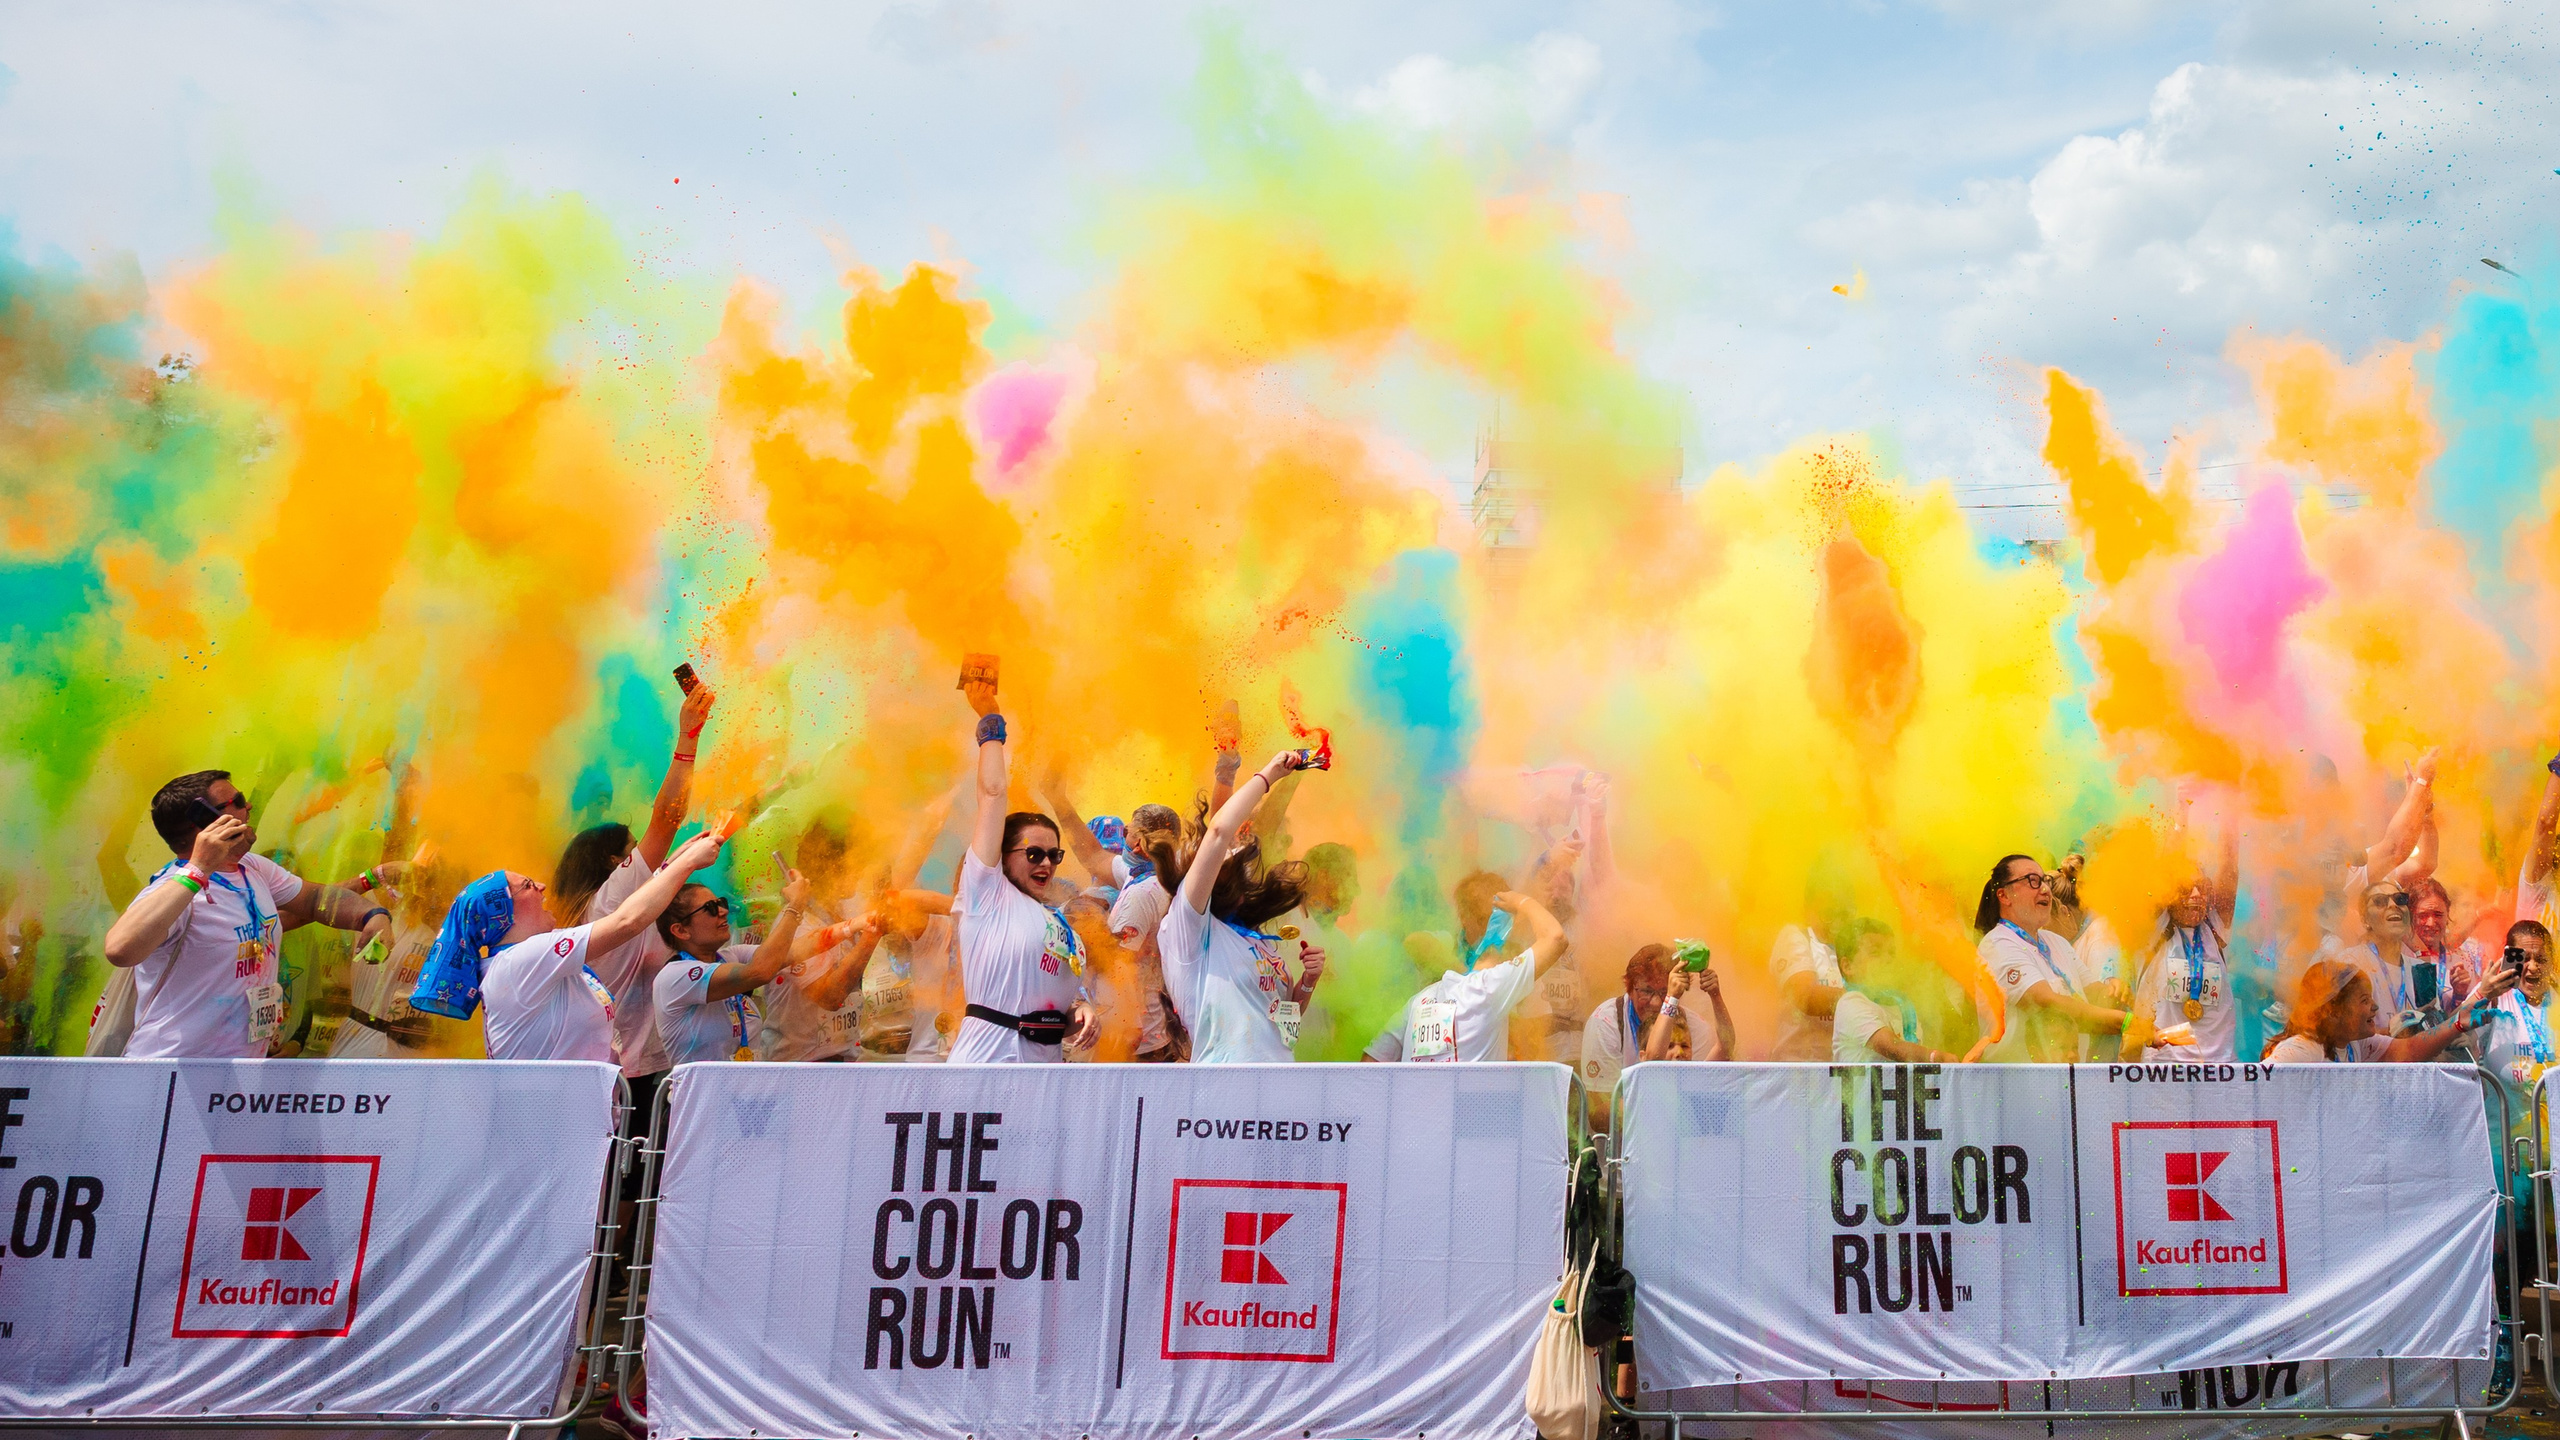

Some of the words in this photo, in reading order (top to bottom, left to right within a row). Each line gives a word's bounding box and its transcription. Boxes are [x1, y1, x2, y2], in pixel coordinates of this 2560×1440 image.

[968, 667, 994, 679] COLOR
[874, 988, 904, 1006] 17563
[2182, 976, 2210, 994] 156
[256, 1004, 276, 1027] 15390
[831, 1011, 857, 1032] 16138
[1417, 1023, 1441, 1043] 18119
[2512, 1042, 2533, 1057] THE
[2109, 1063, 2236, 1083] POWERED
[2244, 1063, 2275, 1083] BY
[207, 1093, 346, 1114] POWERED
[354, 1094, 391, 1114] BY
[1829, 1064, 1942, 1142] THE
[1176, 1118, 1309, 1141] POWERED
[1318, 1122, 1353, 1143] BY
[885, 1112, 1002, 1193] THE
[1831, 1145, 2032, 1228] COLOR
[0, 1175, 104, 1259] OR
[872, 1198, 1083, 1281] COLOR
[2136, 1238, 2267, 1265] Kaufland
[1832, 1231, 1954, 1315] RUN
[1955, 1285, 1972, 1302] TM
[198, 1278, 339, 1306] Kaufland
[863, 1286, 996, 1370] RUN
[993, 1342, 1011, 1359] TM
[1183, 1300, 1318, 1330] Kaufland
